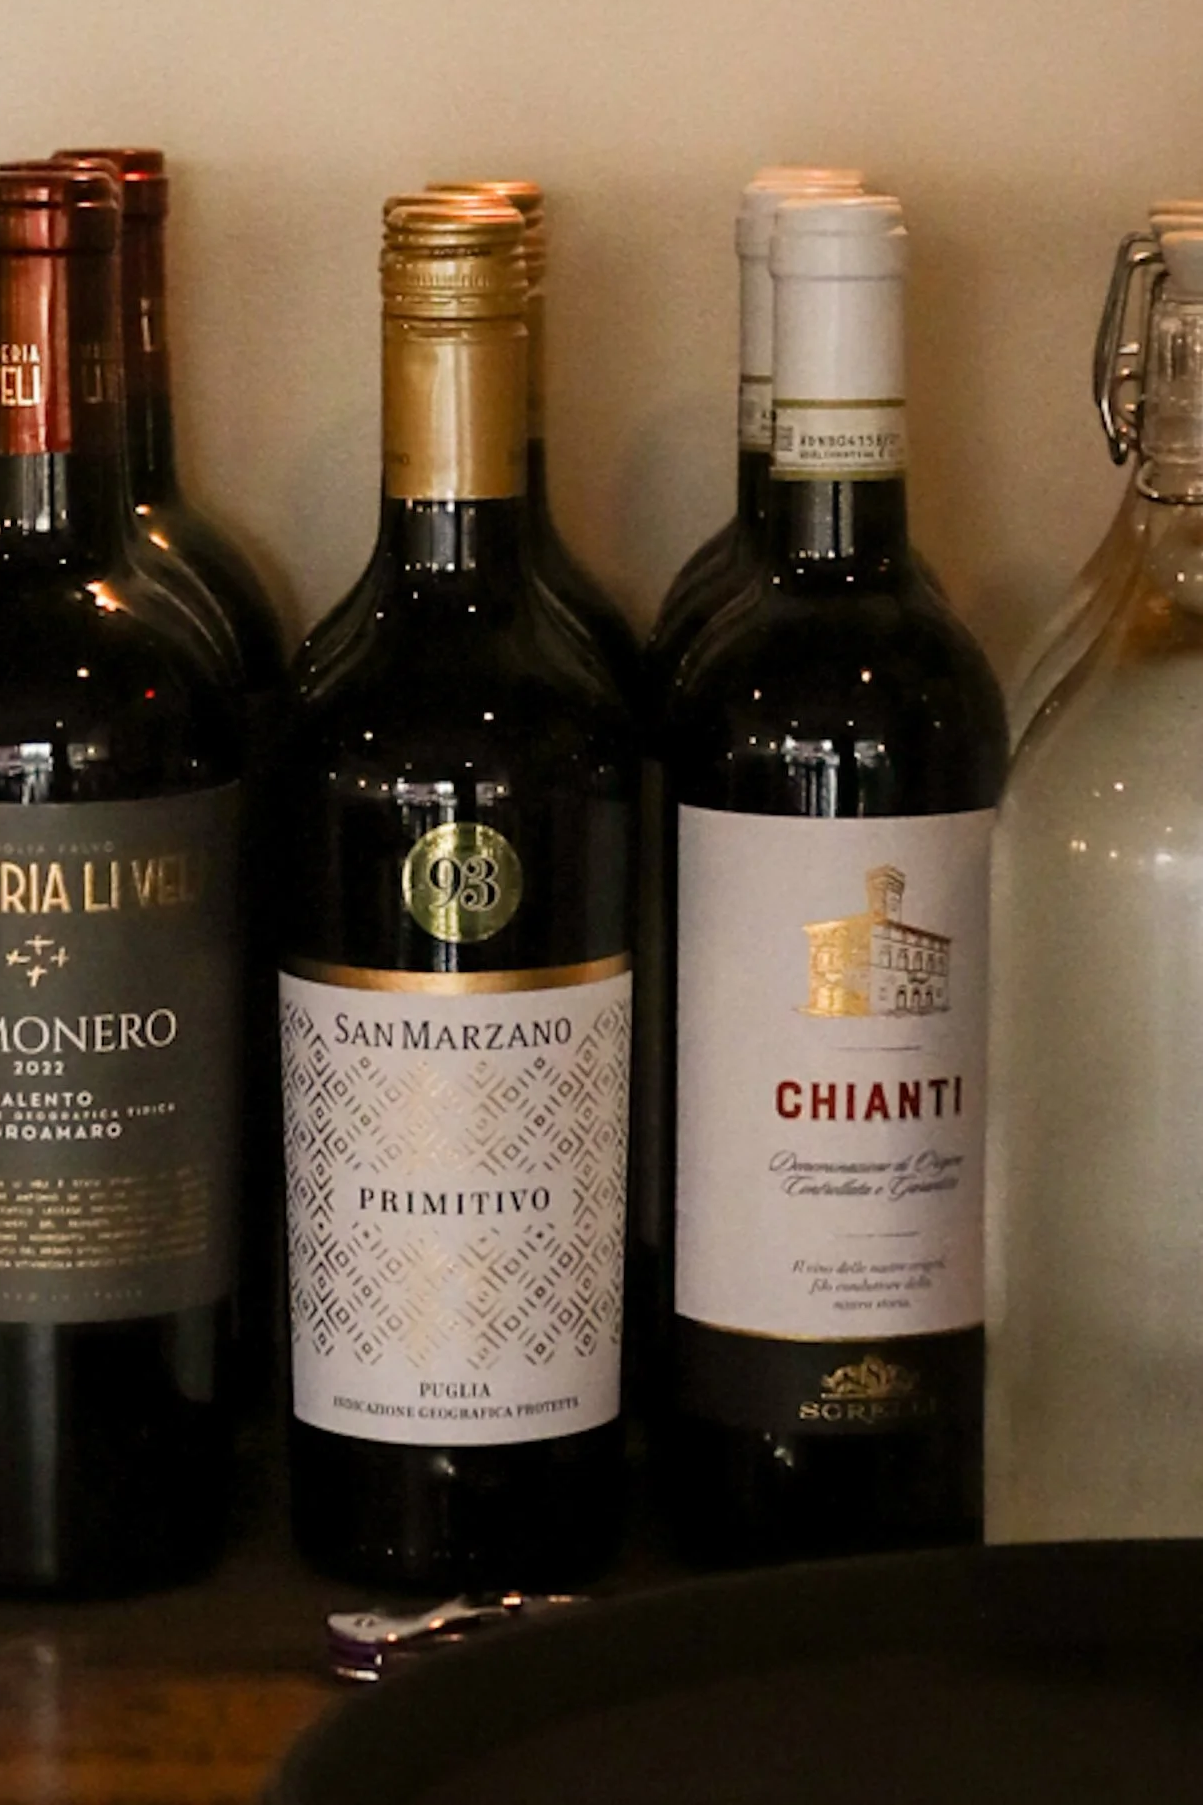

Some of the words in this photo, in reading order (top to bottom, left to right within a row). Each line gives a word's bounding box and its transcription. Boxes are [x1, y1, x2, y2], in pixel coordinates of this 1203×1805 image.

[82, 859, 120, 913] LI
[429, 857, 501, 912] 93
[402, 1016, 573, 1051] MARZANO
[13, 1060, 66, 1076] 2022
[776, 1075, 962, 1120] CHIANTI
[360, 1186, 551, 1215] PRIMITIVO
[419, 1381, 492, 1398] PUGLIA
